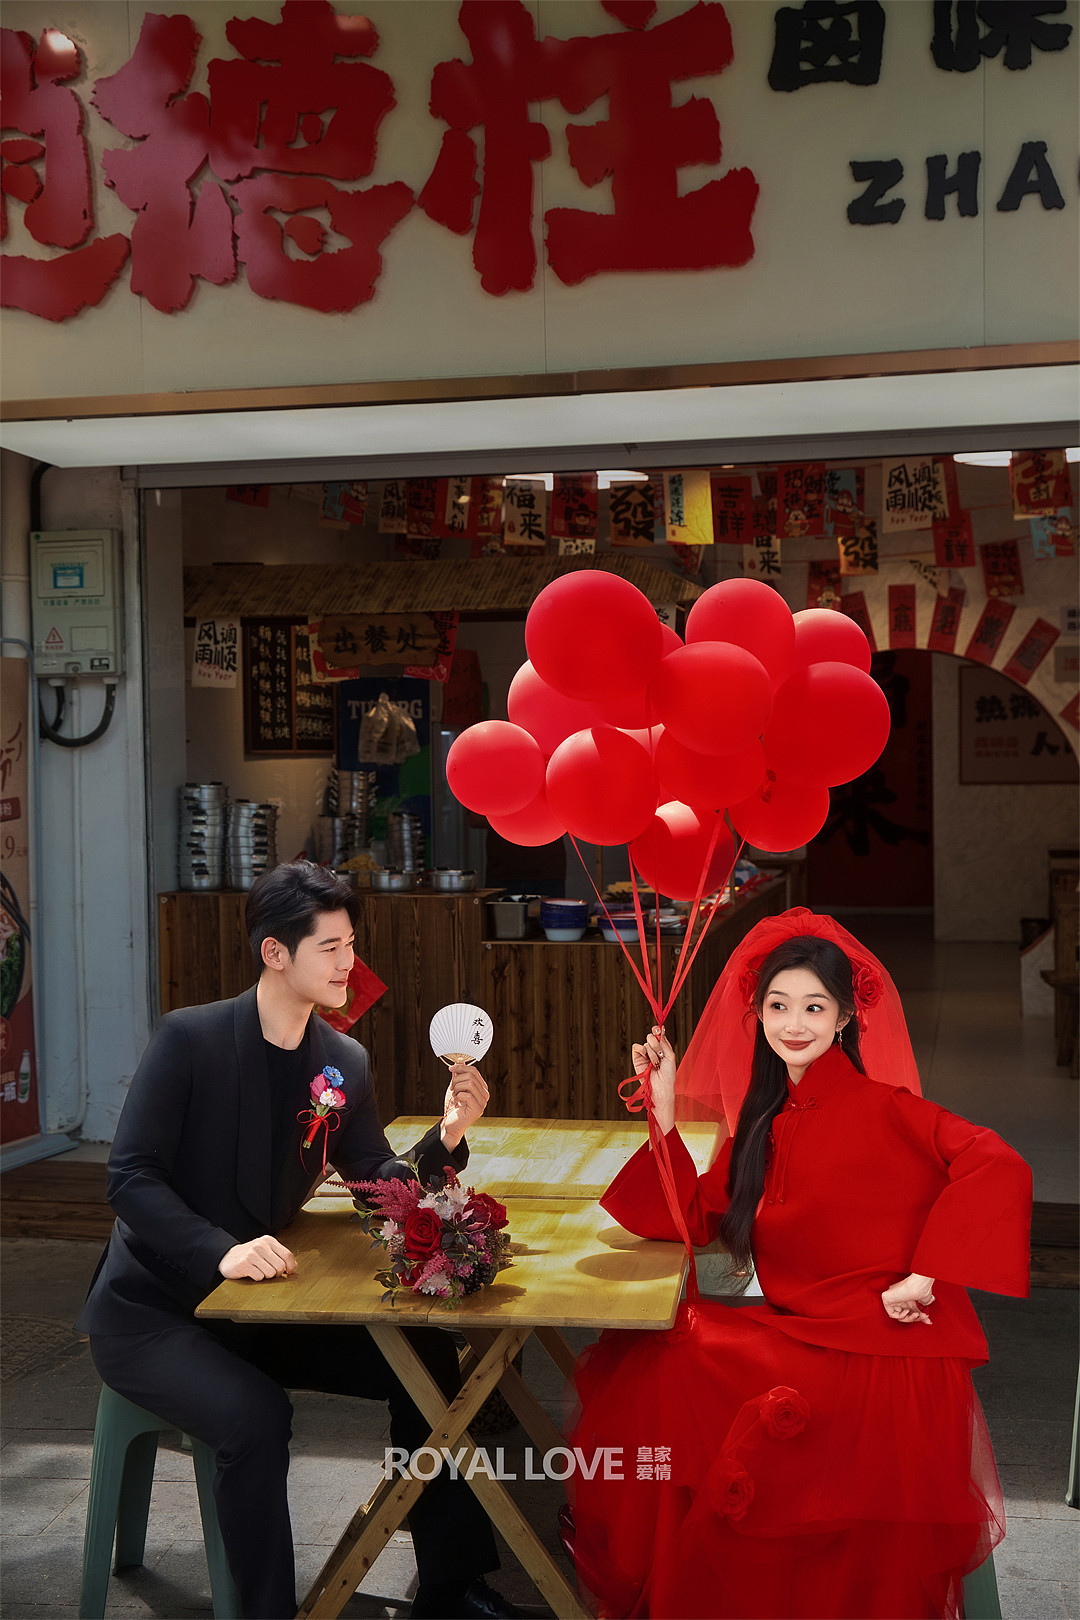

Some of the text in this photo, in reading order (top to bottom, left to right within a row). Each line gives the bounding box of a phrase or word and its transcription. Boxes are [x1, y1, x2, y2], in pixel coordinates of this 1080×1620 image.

[847, 141, 1080, 225] ZHA
[888, 464, 932, 489] 风调
[718, 485, 745, 539] 吉祥
[198, 621, 238, 645] 风调
[334, 623, 427, 655] 出餐处
[195, 644, 238, 672] 雨顺
[471, 1017, 485, 1045] 欢喜
